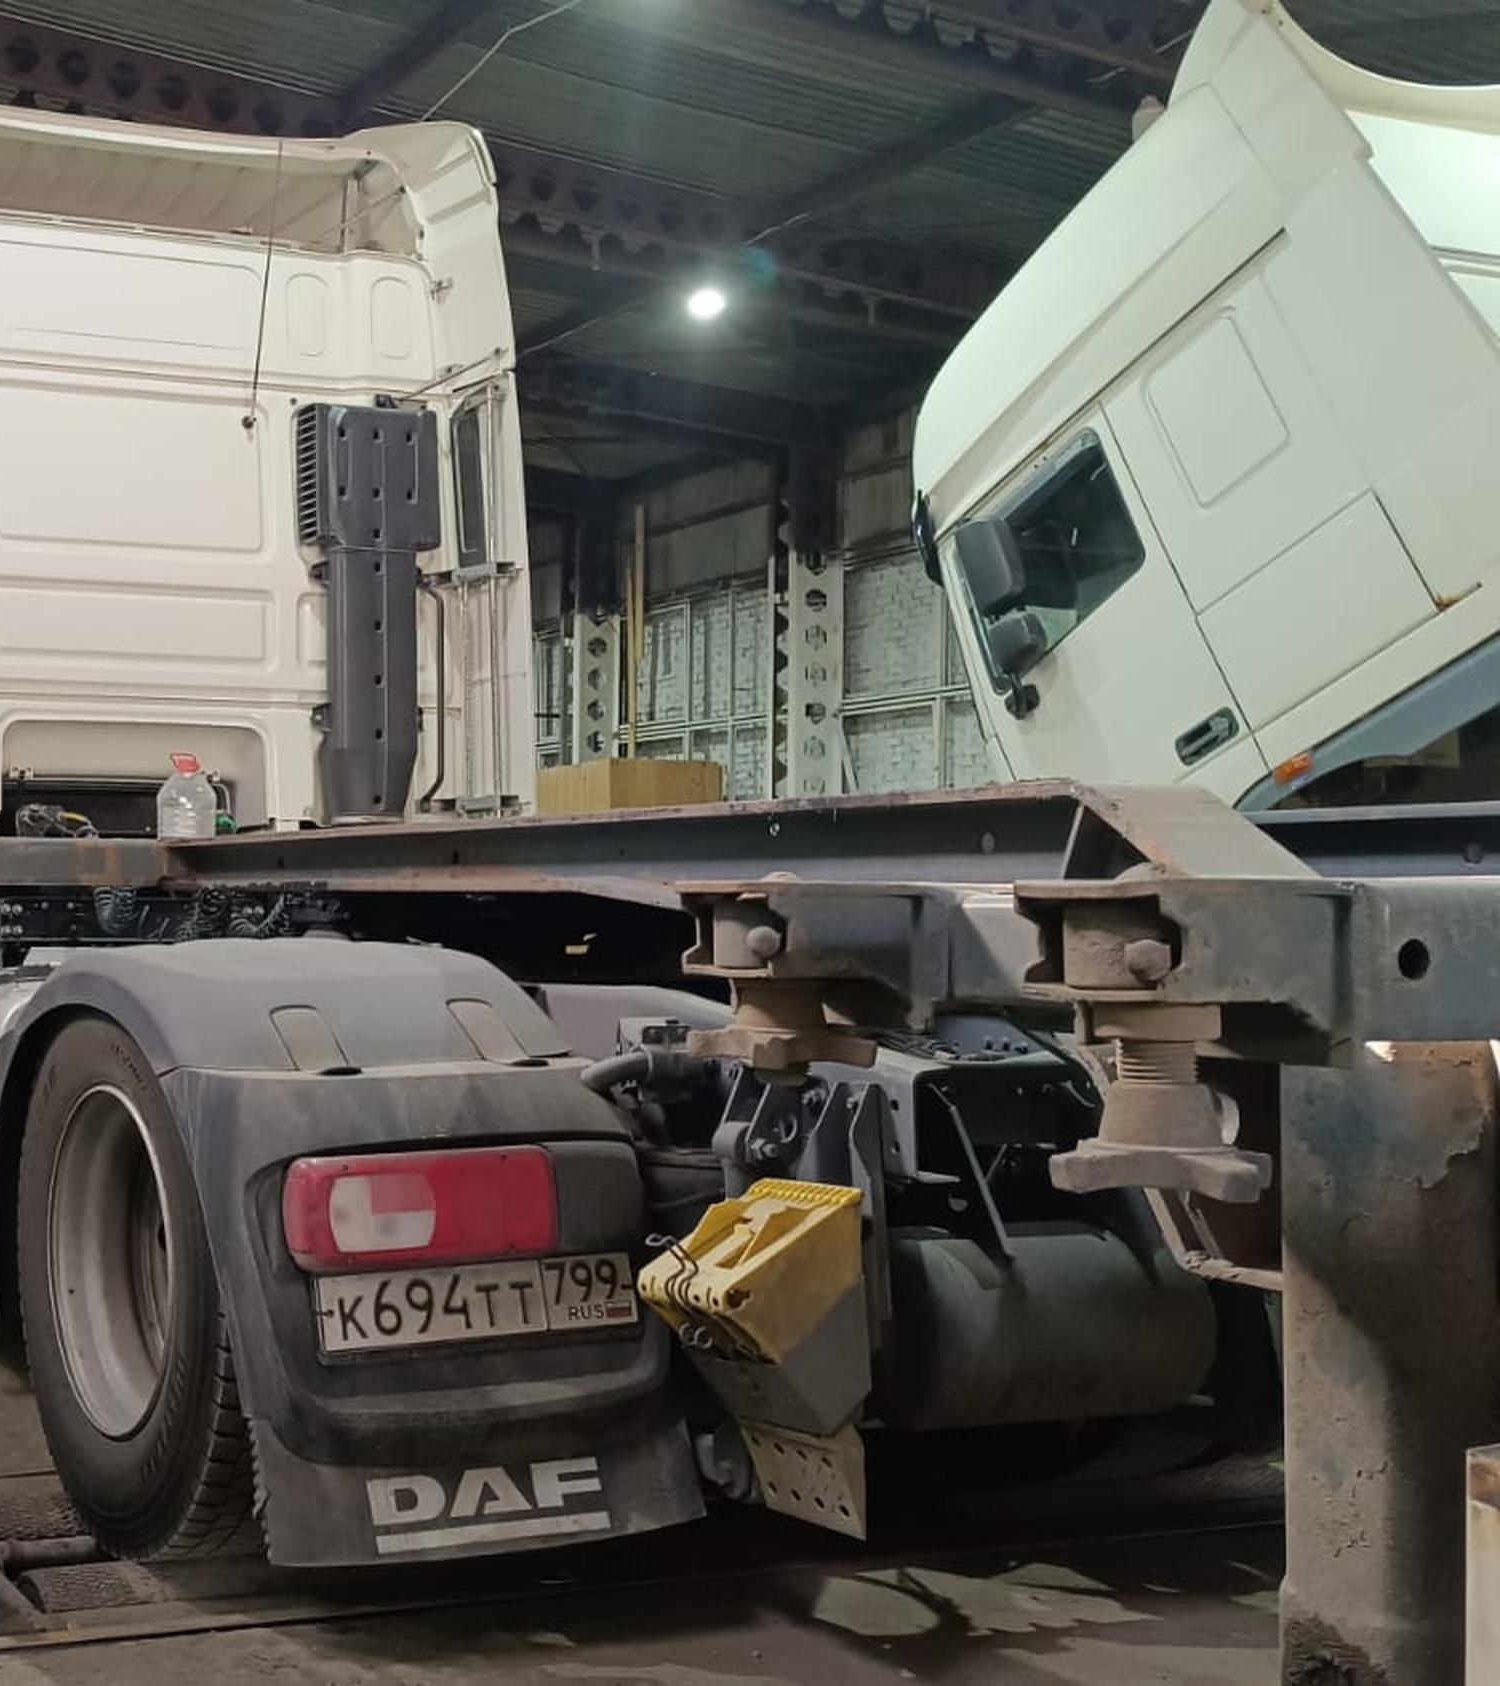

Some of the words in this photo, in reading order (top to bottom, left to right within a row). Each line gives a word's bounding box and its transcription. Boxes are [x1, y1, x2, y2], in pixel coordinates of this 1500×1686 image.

[545, 1259, 618, 1306] 799
[568, 1303, 605, 1322] RUS
[366, 1457, 602, 1526] DAF
